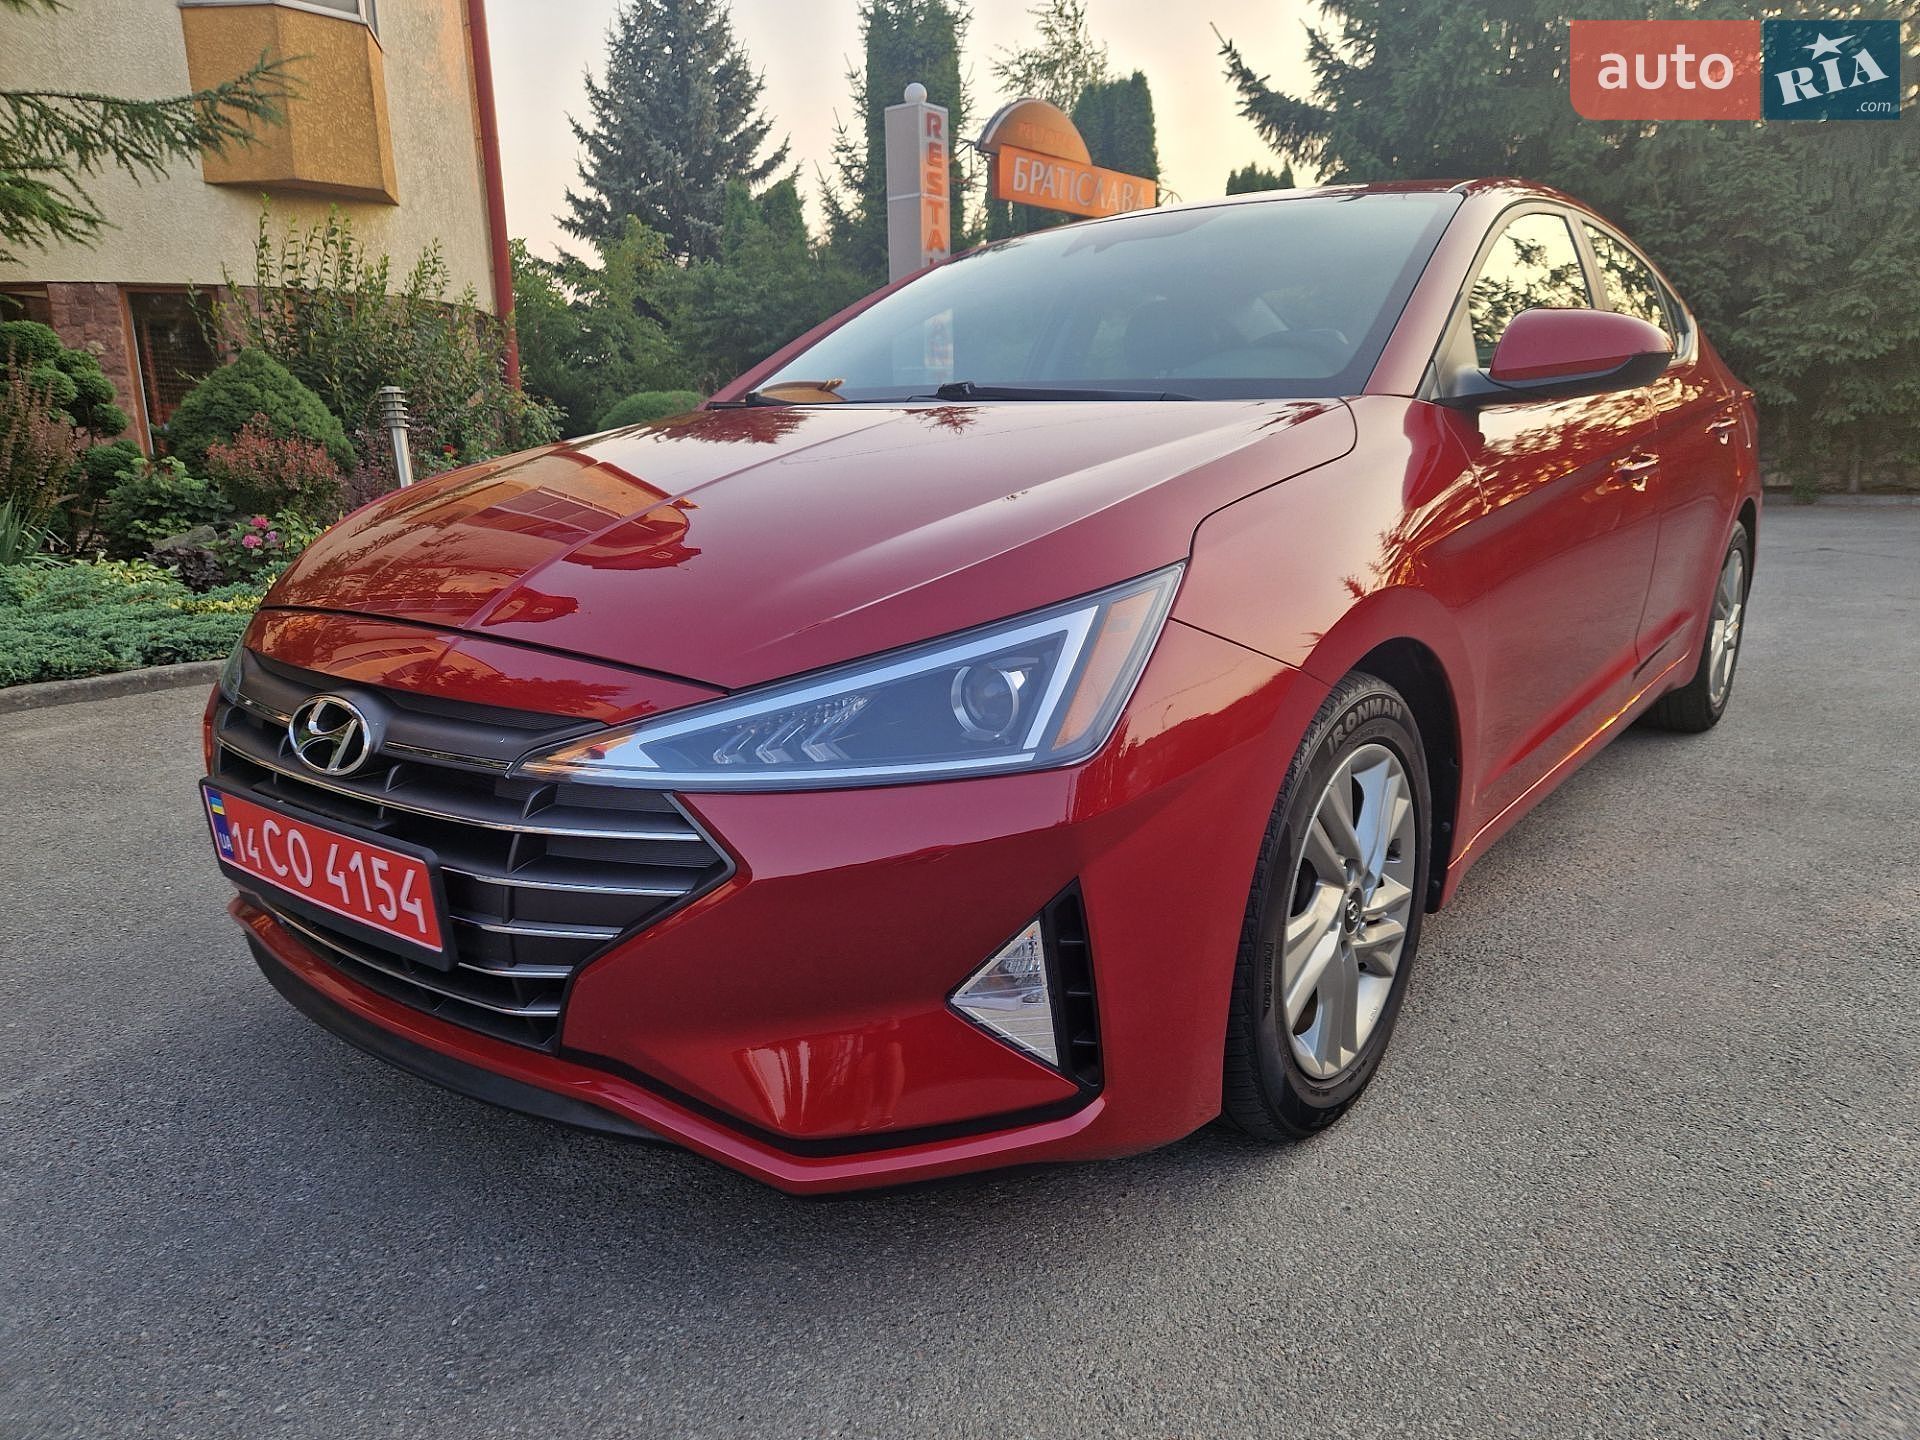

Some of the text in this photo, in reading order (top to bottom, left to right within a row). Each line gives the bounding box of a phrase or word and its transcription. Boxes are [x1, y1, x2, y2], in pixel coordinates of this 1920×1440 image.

[926, 112, 943, 266] RESTA
[1327, 698, 1402, 756] IRONMAN
[217, 830, 233, 854] UA
[325, 843, 428, 934] 4154
